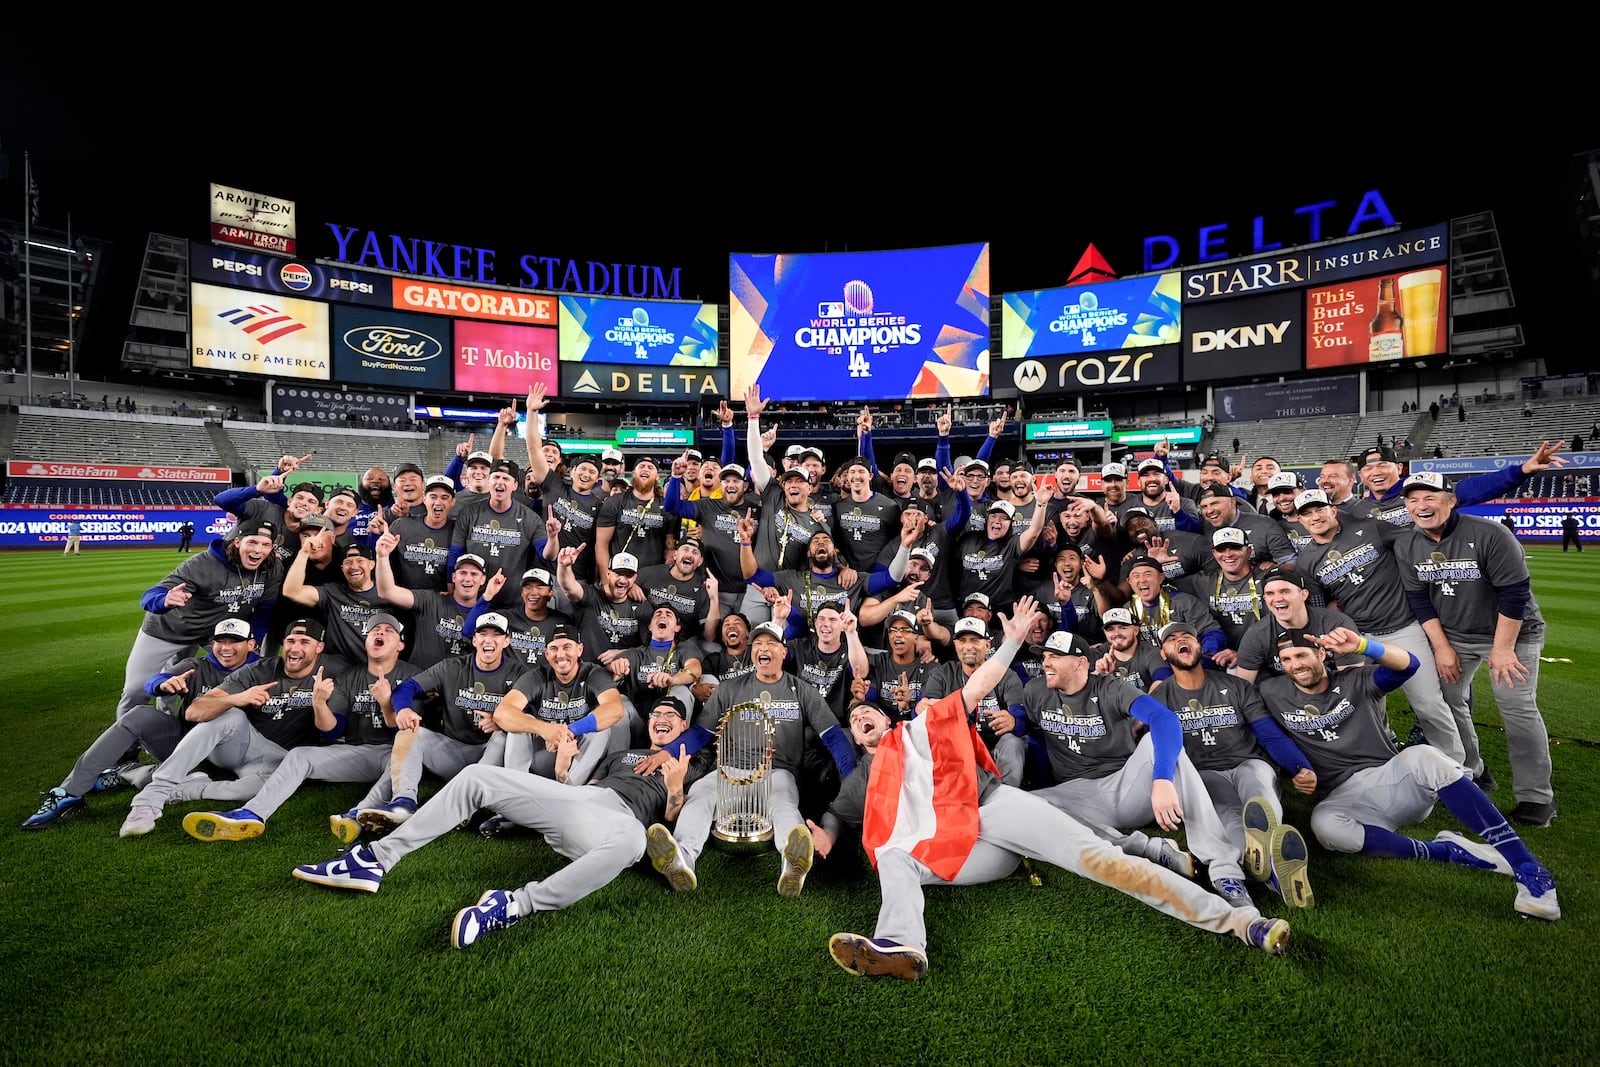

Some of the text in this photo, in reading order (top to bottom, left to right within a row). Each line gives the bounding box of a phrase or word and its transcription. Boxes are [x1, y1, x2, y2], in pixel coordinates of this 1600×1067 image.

[215, 191, 291, 214] ARMITRON
[219, 226, 288, 246] ARMITRON
[1143, 189, 1396, 272] DELTA
[211, 257, 263, 277] PEPSI
[325, 222, 683, 299] YANKEE STADIUM
[1186, 236, 1441, 299] STARR INSURANCE
[281, 271, 312, 282] PEPSI
[330, 277, 374, 295] PEPSI
[403, 285, 550, 319] GATORADE
[1312, 288, 1355, 306] This
[1313, 301, 1364, 320] Bud's
[810, 316, 906, 328] WORLD SERIES
[1049, 312, 1128, 333] CHAMPIONS
[1313, 321, 1345, 335] For
[362, 329, 425, 358] Ford
[605, 329, 675, 345] CHAMPIONS
[794, 324, 922, 348] CHAMPIONS
[1192, 320, 1291, 353] DKNY
[1312, 336, 1353, 349] You.
[196, 346, 326, 369] BANK OF AMERICA
[461, 346, 552, 371] T Mobile
[848, 346, 872, 377] LA
[361, 360, 426, 373] BuyFordNow.com
[1059, 352, 1154, 387] razr
[611, 371, 719, 394] DELTA
[1275, 405, 1327, 417] THE BOSS
[1436, 461, 1475, 469] FANDUEL
[557, 497, 594, 523] WORLD SERIES
[716, 514, 738, 523] WORL
[840, 514, 881, 525] WORLD SERIES
[1536, 514, 1585, 528] SERS
[27, 521, 71, 534] WORL
[80, 521, 121, 534] SERIES
[472, 526, 522, 538] WORLD SERIES
[853, 527, 862, 541] LA
[405, 544, 433, 553] WORLD
[490, 543, 500, 557] LA
[425, 561, 435, 574] LA
[1316, 543, 1375, 578] WORLD SERIES
[1442, 560, 1478, 571] SERIES
[977, 569, 988, 581] LA
[1348, 571, 1365, 586] LA
[1441, 582, 1456, 596] LA
[650, 588, 697, 606] WORLD SERIES
[800, 593, 825, 601] WRLD
[340, 605, 369, 615] WORLD
[511, 631, 532, 642] WORLD
[451, 641, 460, 654] LA
[527, 650, 537, 664] LA
[770, 701, 799, 710] SERIES
[1203, 706, 1236, 717] SERIES
[371, 713, 382, 728] LA
[1041, 711, 1104, 726] WORLD SERIES
[1181, 715, 1238, 730] HAMPIONS
[1040, 720, 1107, 737] CHAMPIONS
[1318, 728, 1340, 742] LA
[1201, 728, 1216, 746] LA
[1067, 736, 1082, 754] LA
